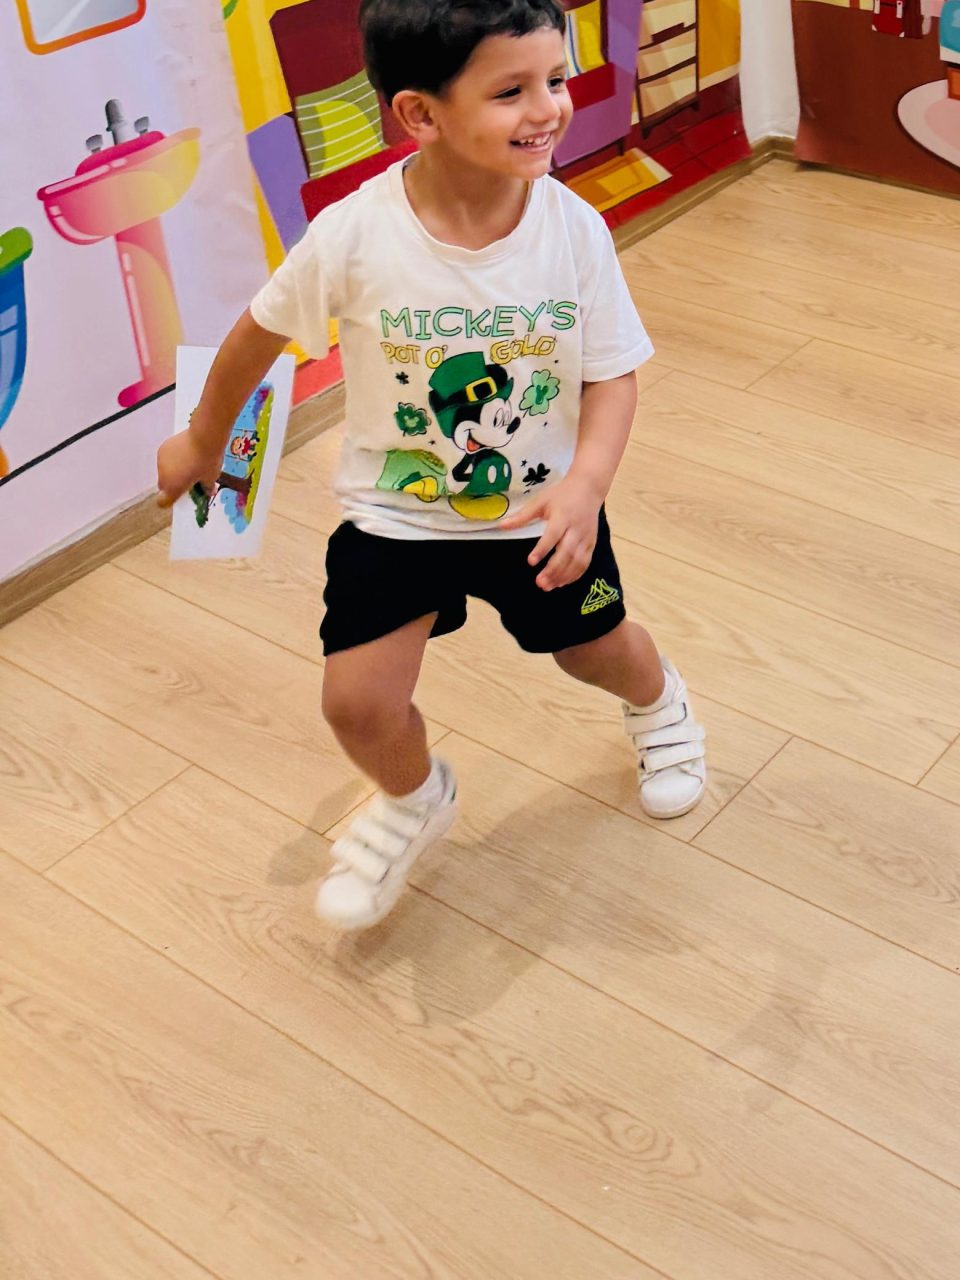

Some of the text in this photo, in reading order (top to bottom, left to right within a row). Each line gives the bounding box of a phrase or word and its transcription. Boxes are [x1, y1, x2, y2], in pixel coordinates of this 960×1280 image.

[380, 299, 578, 340] MICKEY'S
[380, 341, 421, 365] POT
[490, 334, 557, 366] GOLD
